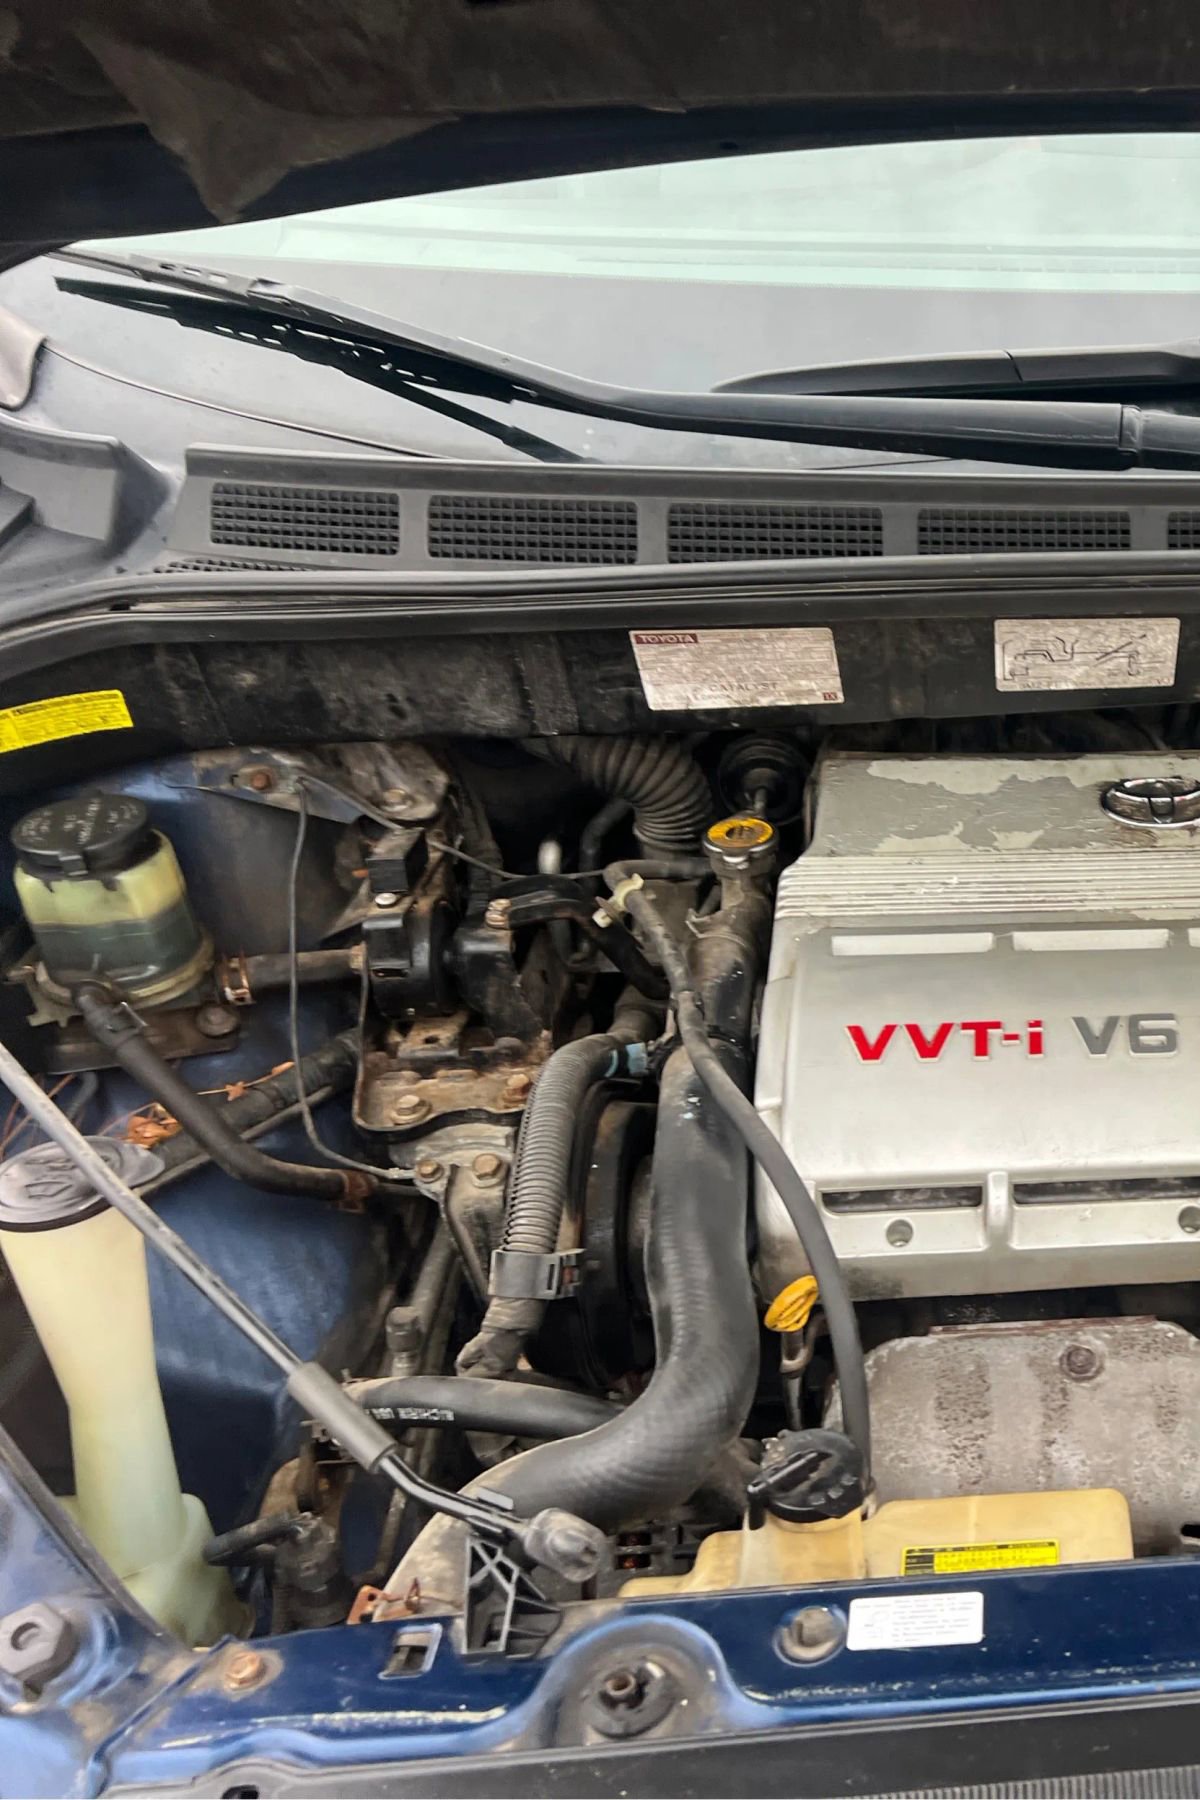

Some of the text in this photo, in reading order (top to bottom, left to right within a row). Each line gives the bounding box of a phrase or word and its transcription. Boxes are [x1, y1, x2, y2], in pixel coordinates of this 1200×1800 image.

[640, 634, 695, 645] TOYOTA
[709, 681, 778, 693] CATALYST
[846, 1019, 1045, 1065] VVT-i
[1072, 1013, 1179, 1058] V6
